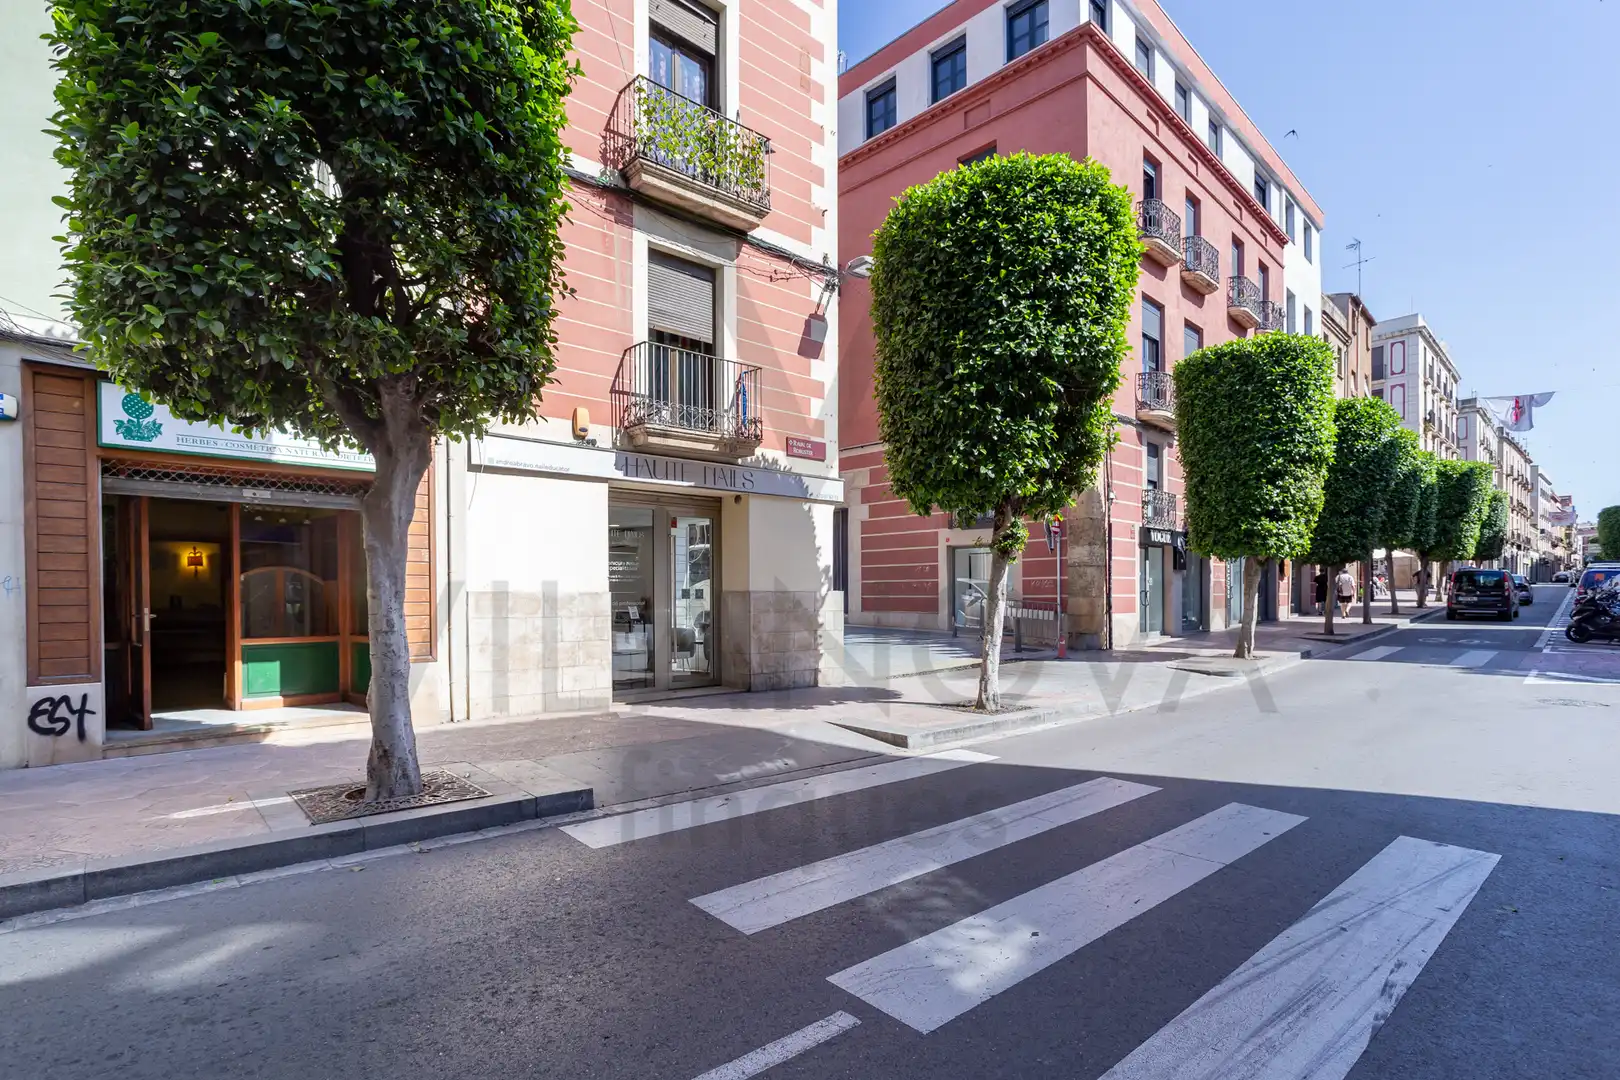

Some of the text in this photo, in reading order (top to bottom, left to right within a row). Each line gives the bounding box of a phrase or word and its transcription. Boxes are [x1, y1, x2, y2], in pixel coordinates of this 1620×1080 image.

[176, 436, 219, 447] HERBES
[622, 456, 755, 490] HAUTE NAILS
[1150, 529, 1172, 544] VOGUE
